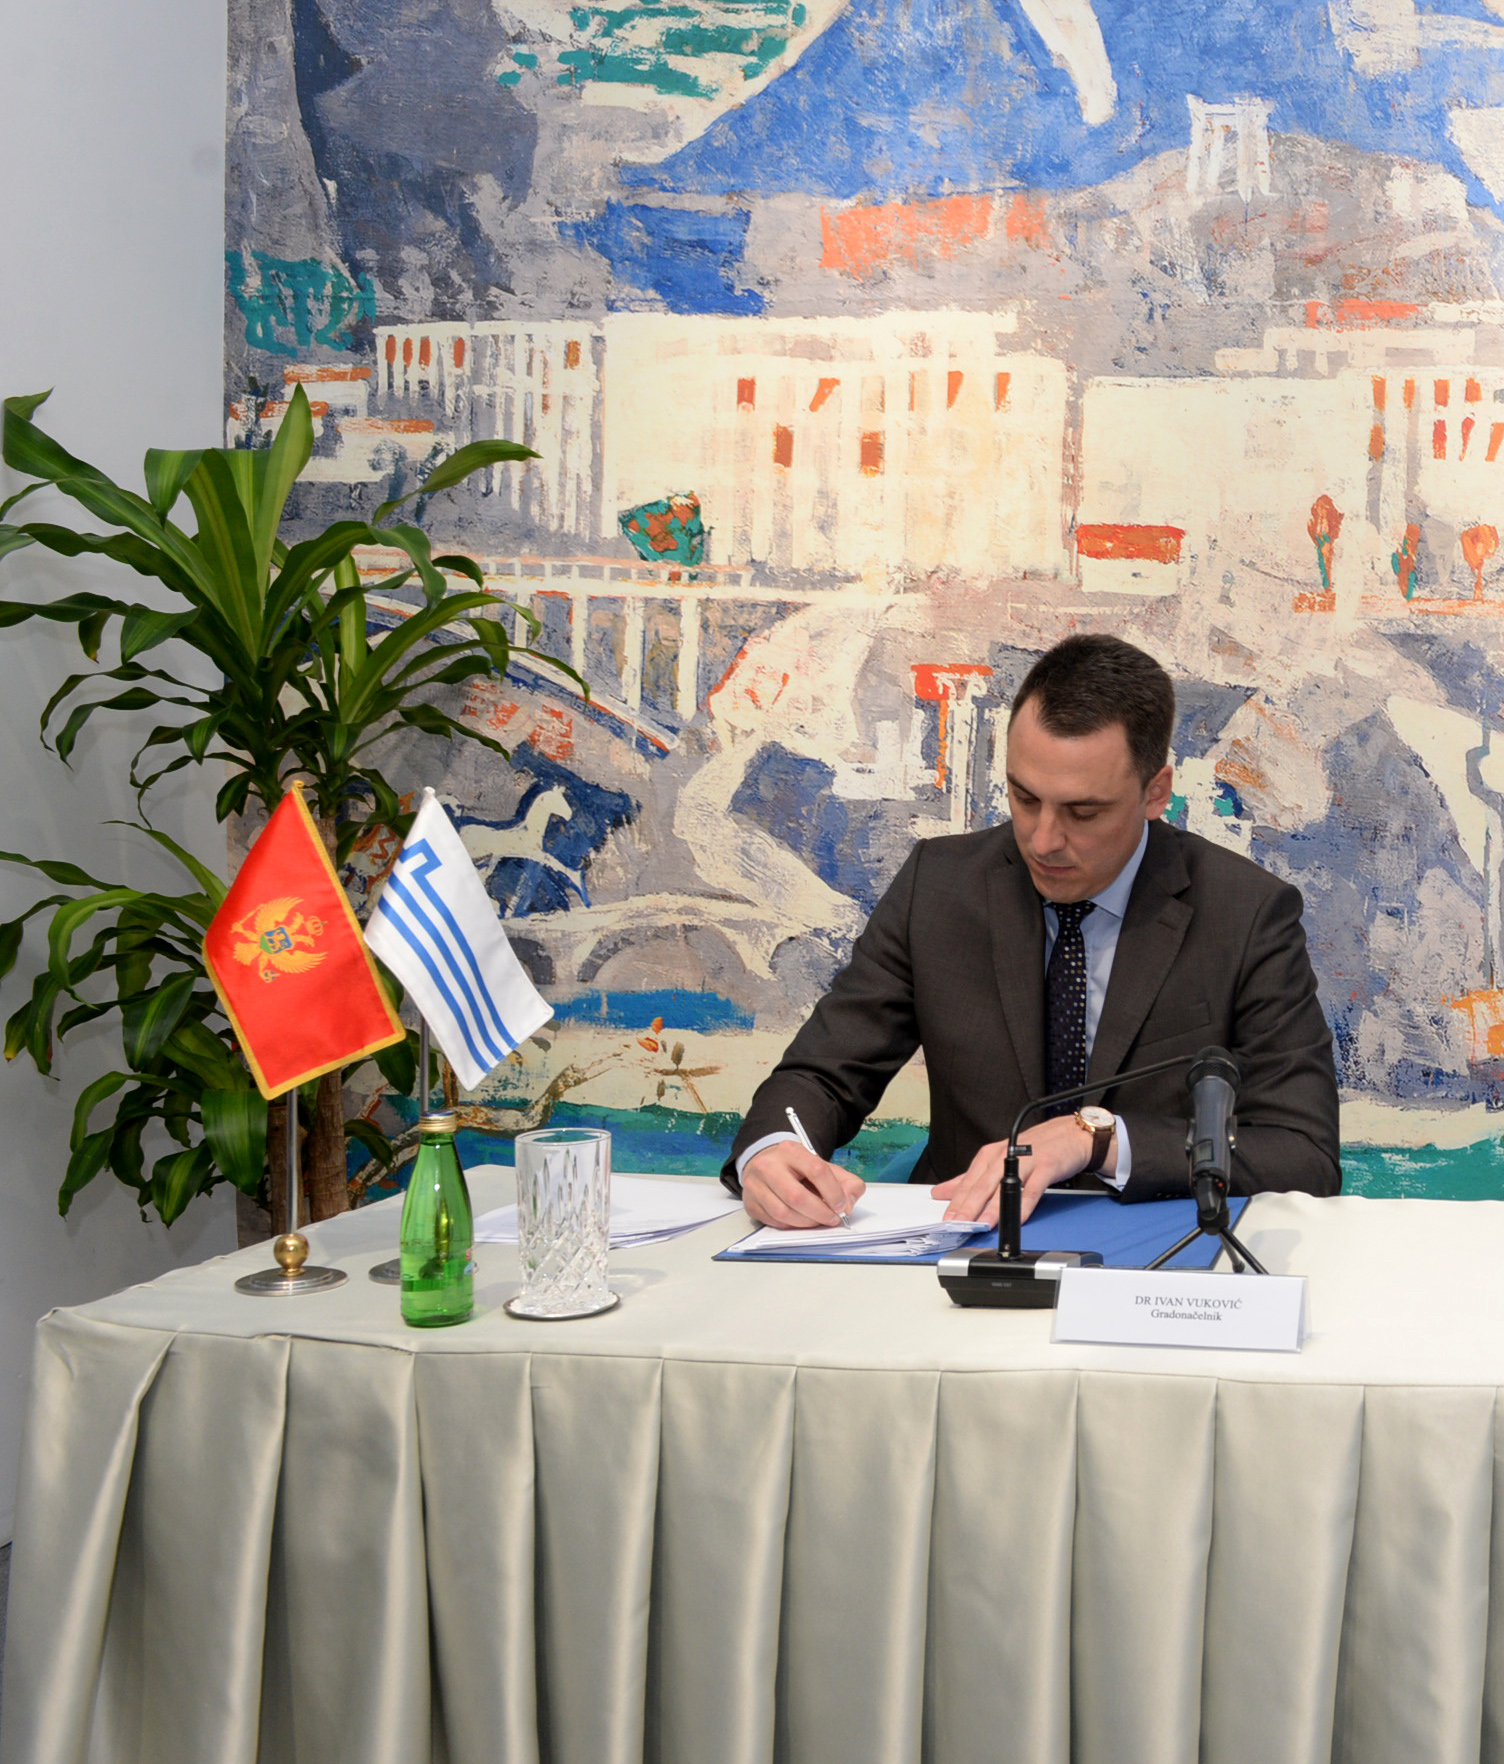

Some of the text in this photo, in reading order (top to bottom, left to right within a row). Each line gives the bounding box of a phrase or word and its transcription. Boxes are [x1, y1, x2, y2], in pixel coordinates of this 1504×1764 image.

[1135, 1295, 1243, 1310] DR IVAN VUKOVIĆ
[1150, 1308, 1223, 1321] Gradonačelnik
